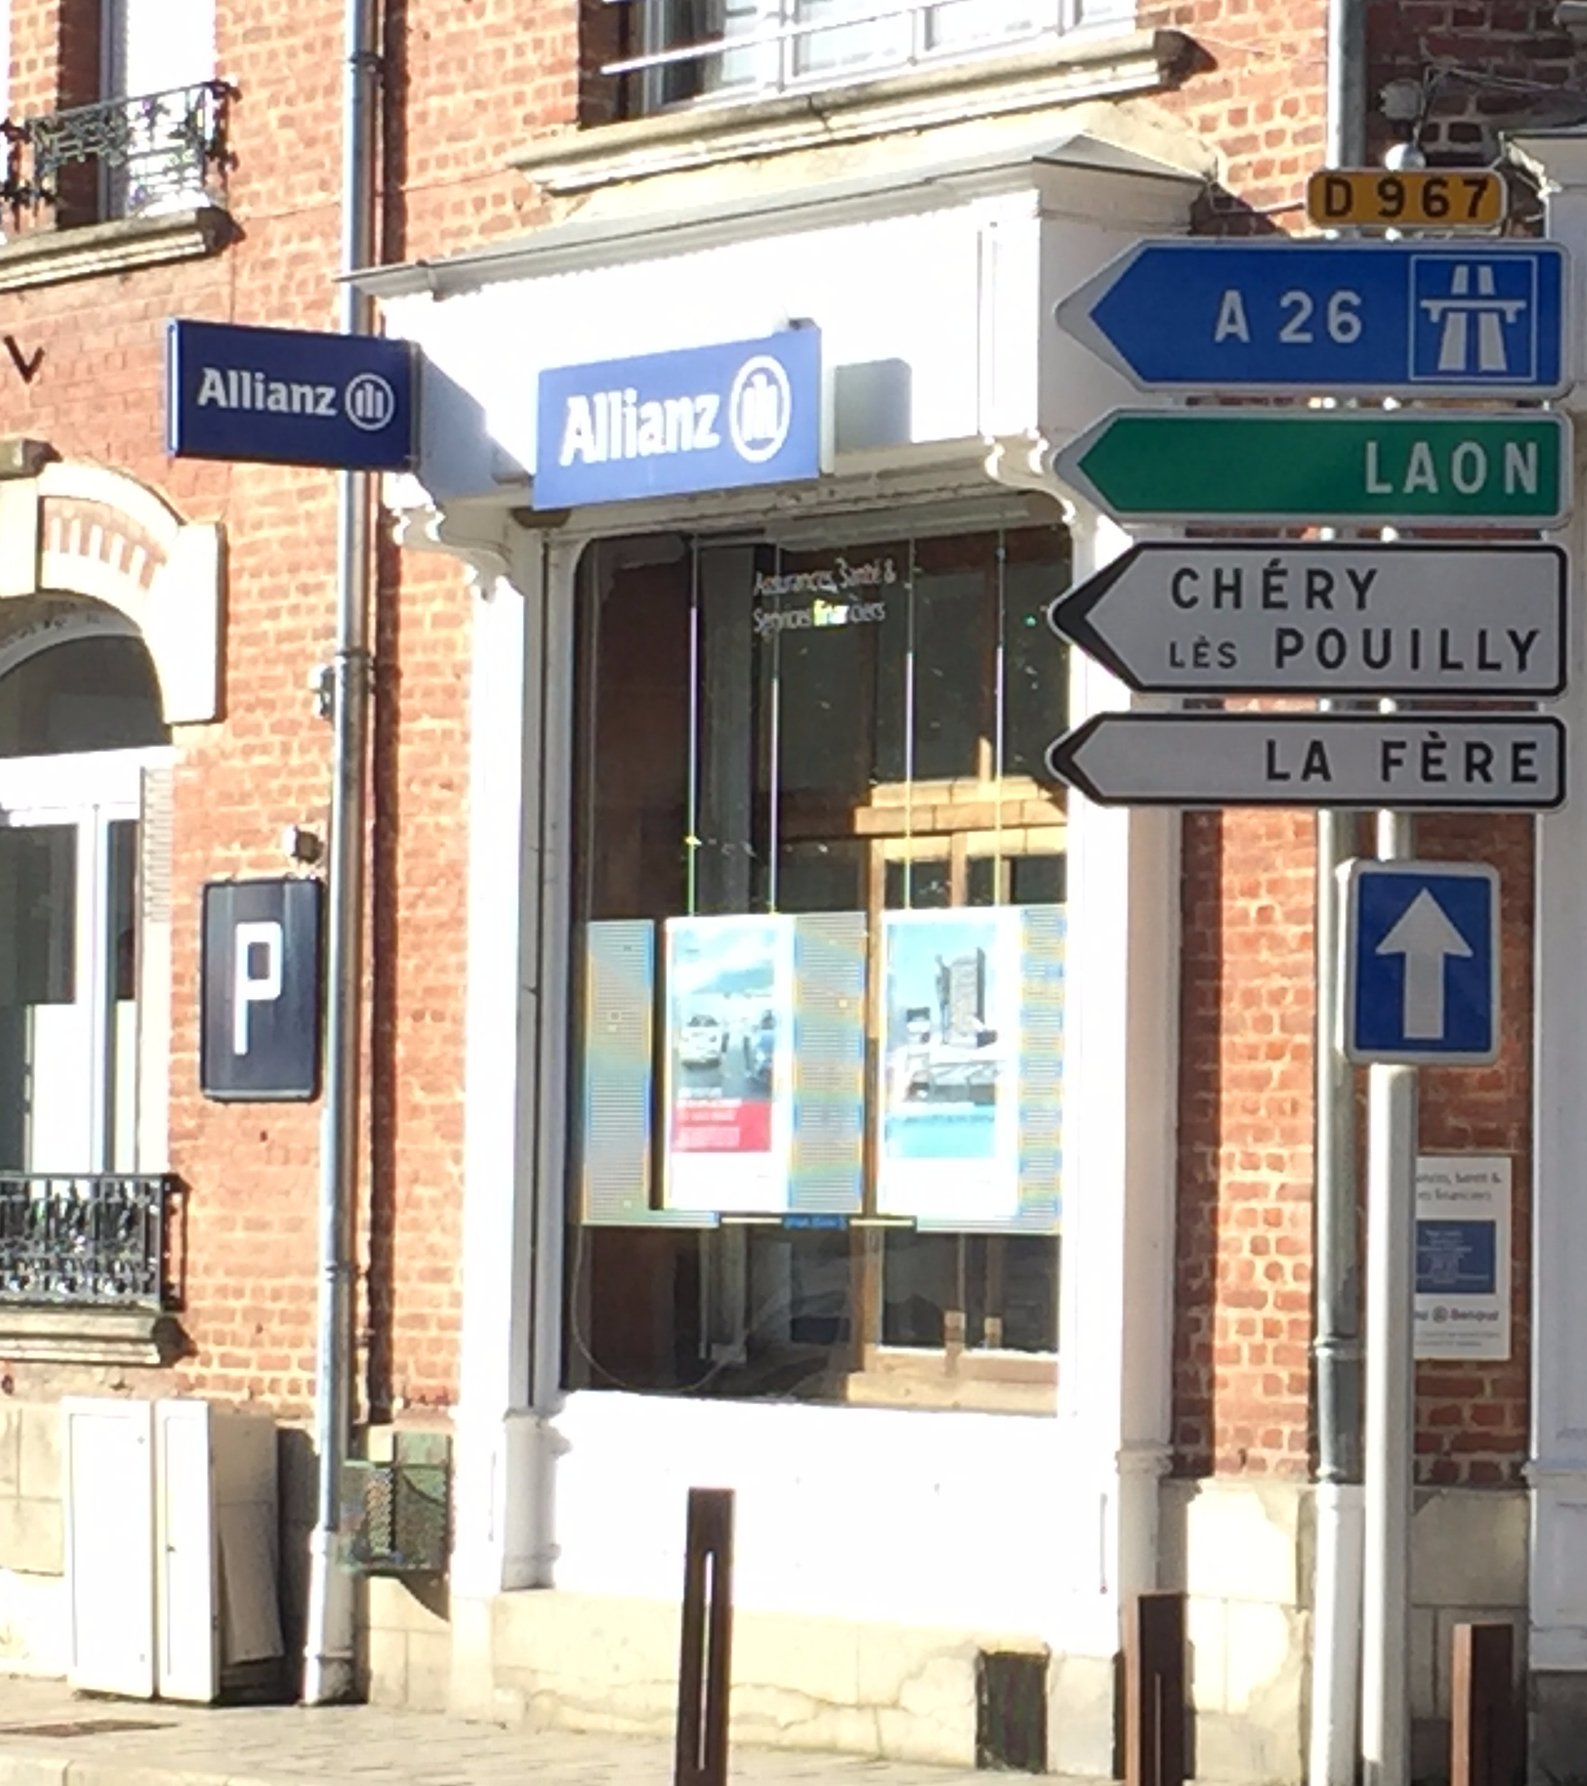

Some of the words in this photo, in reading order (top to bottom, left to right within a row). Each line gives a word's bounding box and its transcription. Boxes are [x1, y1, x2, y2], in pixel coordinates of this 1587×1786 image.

[1324, 178, 1353, 218] D
[1376, 178, 1491, 219] 967
[1214, 290, 1250, 344] A
[1278, 290, 1363, 344] 26
[197, 367, 339, 417] Allianz
[558, 387, 722, 467] Allianz
[1365, 441, 1538, 494] LAON
[1171, 558, 1379, 610] CHÉRY
[1169, 635, 1238, 670] LÈS
[1275, 628, 1541, 672] POUILLY
[1265, 739, 1333, 781] LA
[1381, 731, 1539, 783] FÈRE
[233, 921, 283, 1056] P
